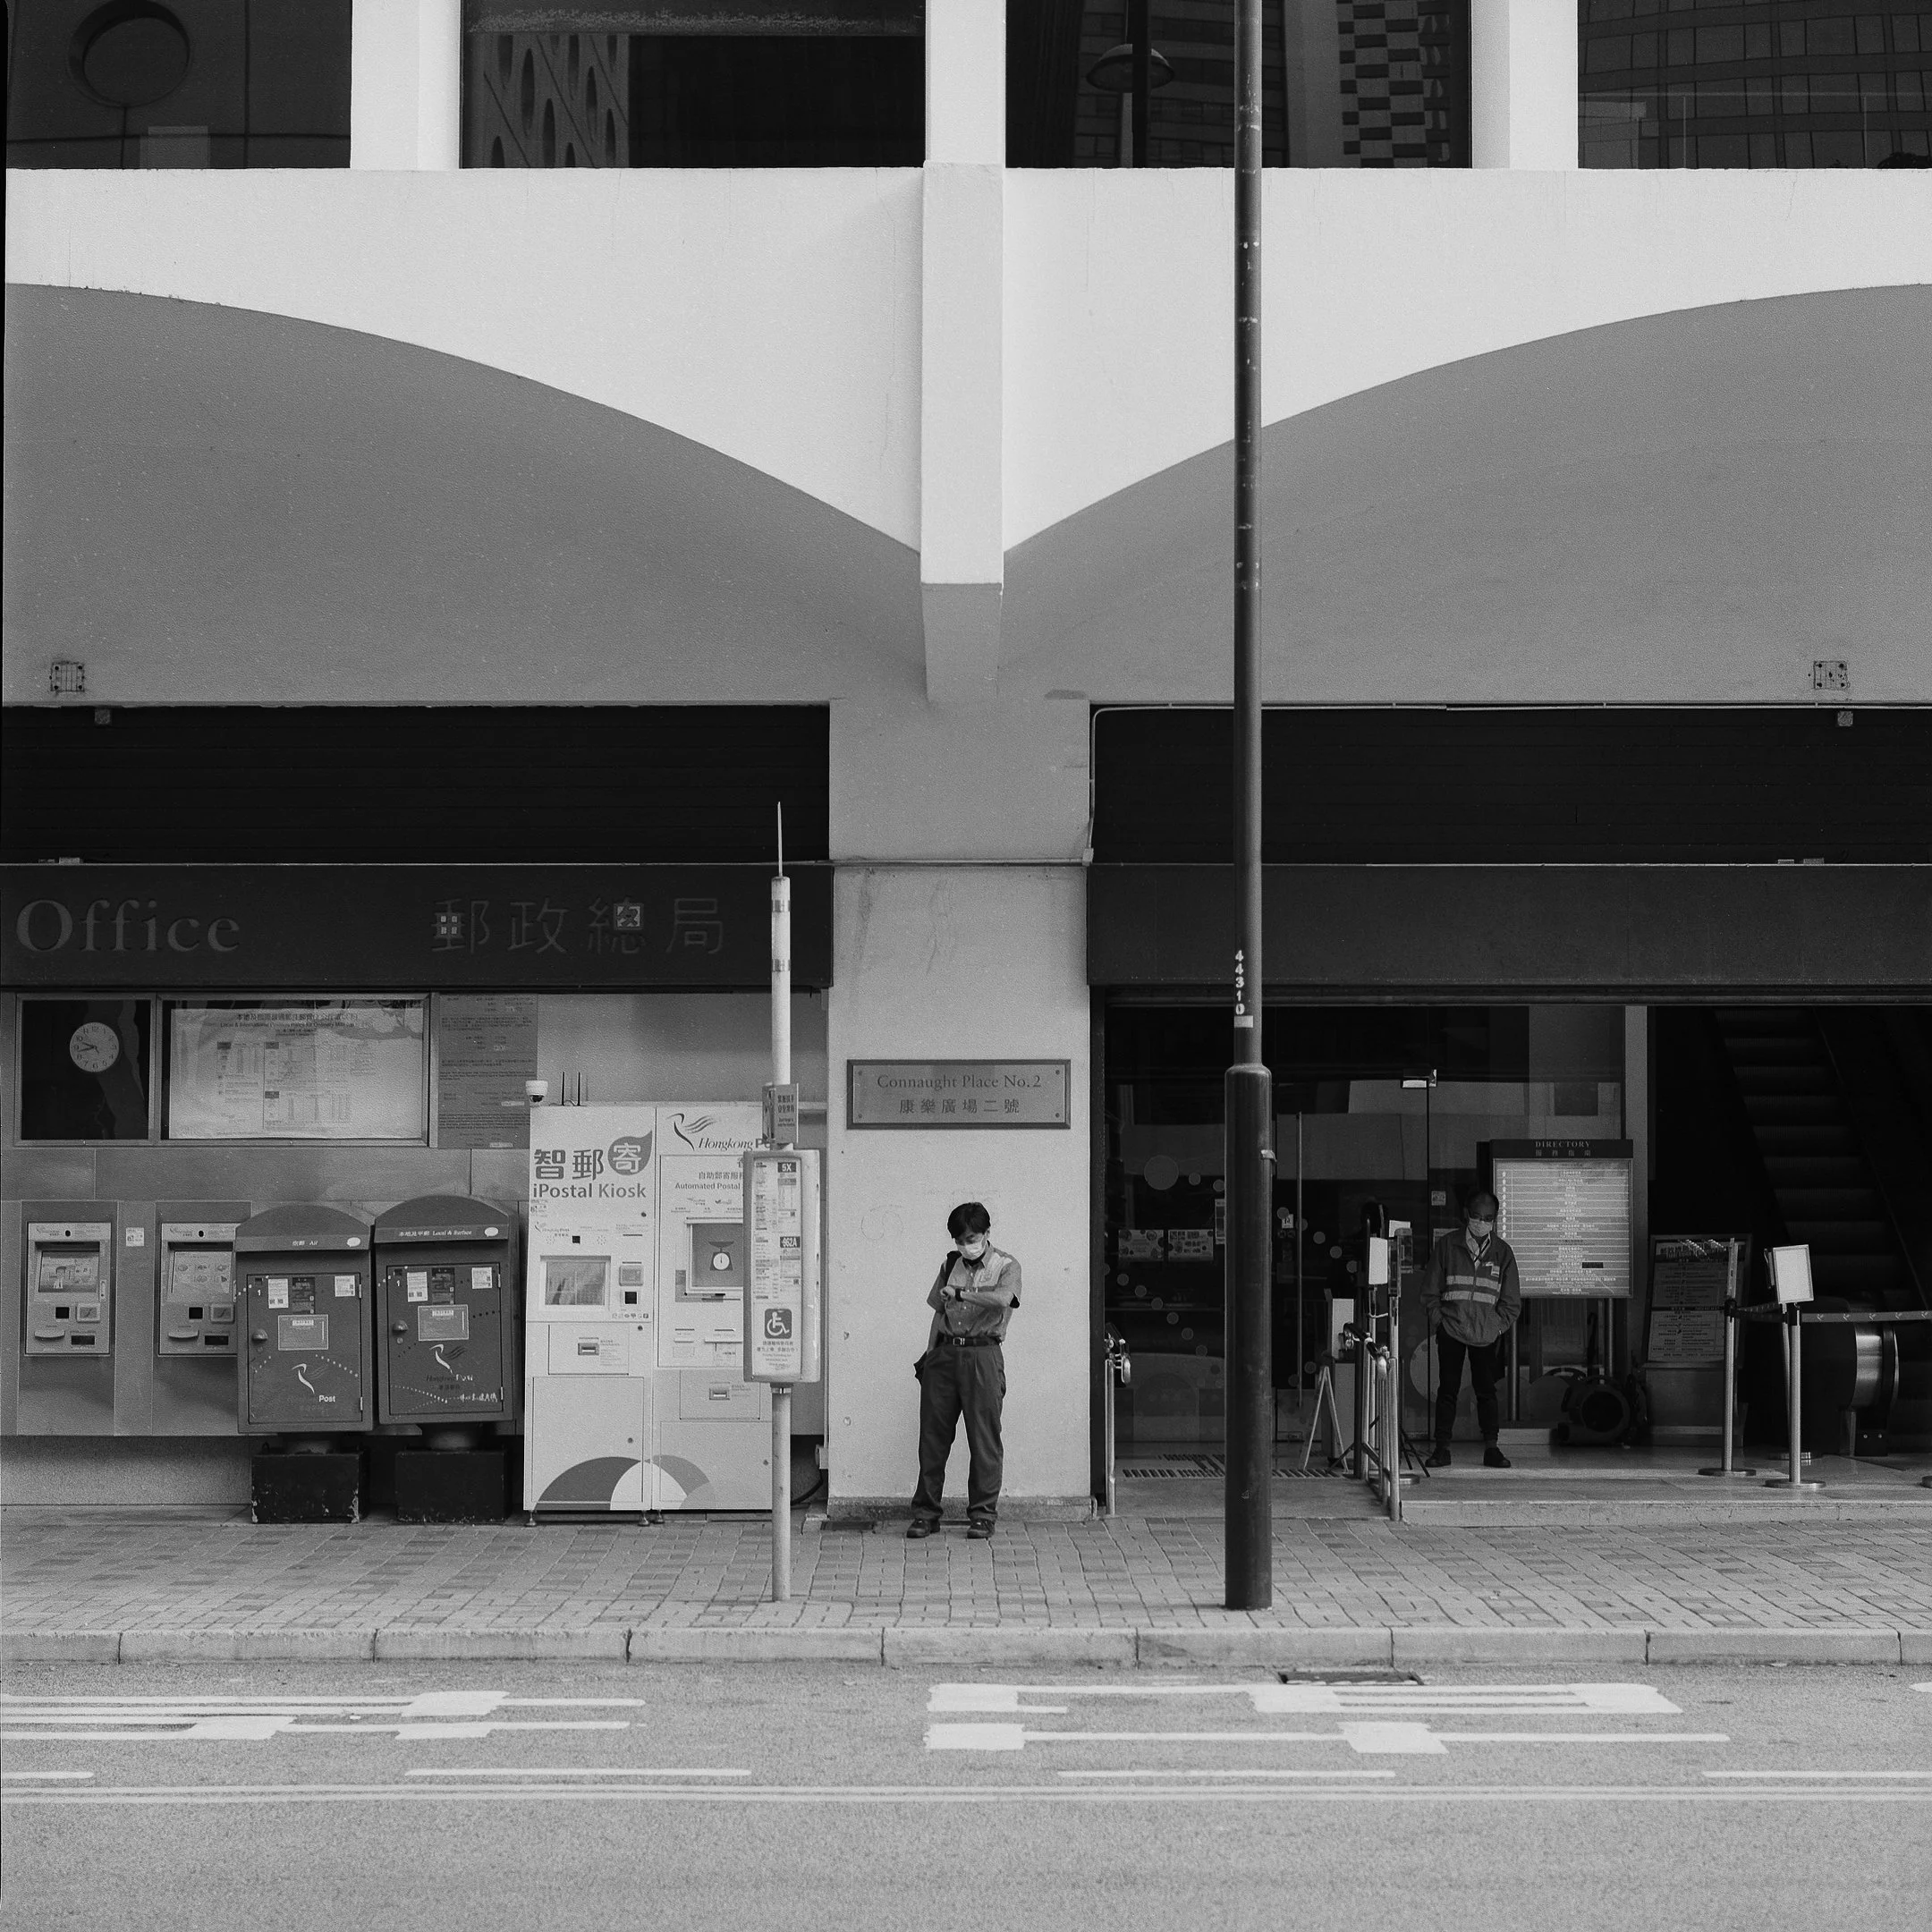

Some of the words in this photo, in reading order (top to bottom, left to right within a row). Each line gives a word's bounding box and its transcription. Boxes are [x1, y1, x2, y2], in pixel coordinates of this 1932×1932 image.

[15, 899, 241, 953] Office
[431, 897, 724, 954] 郵政總局
[1234, 949, 1245, 1015] 44310
[877, 1074, 957, 1091] Connaught
[962, 1074, 999, 1089] Place
[899, 1098, 1020, 1114] 康樂廣場二號
[698, 1138, 753, 1151] Hongkong
[534, 1142, 642, 1181] 智郵寄
[533, 1182, 593, 1199] iPostal
[598, 1182, 647, 1199] Kiosk
[318, 1394, 336, 1402] Post
